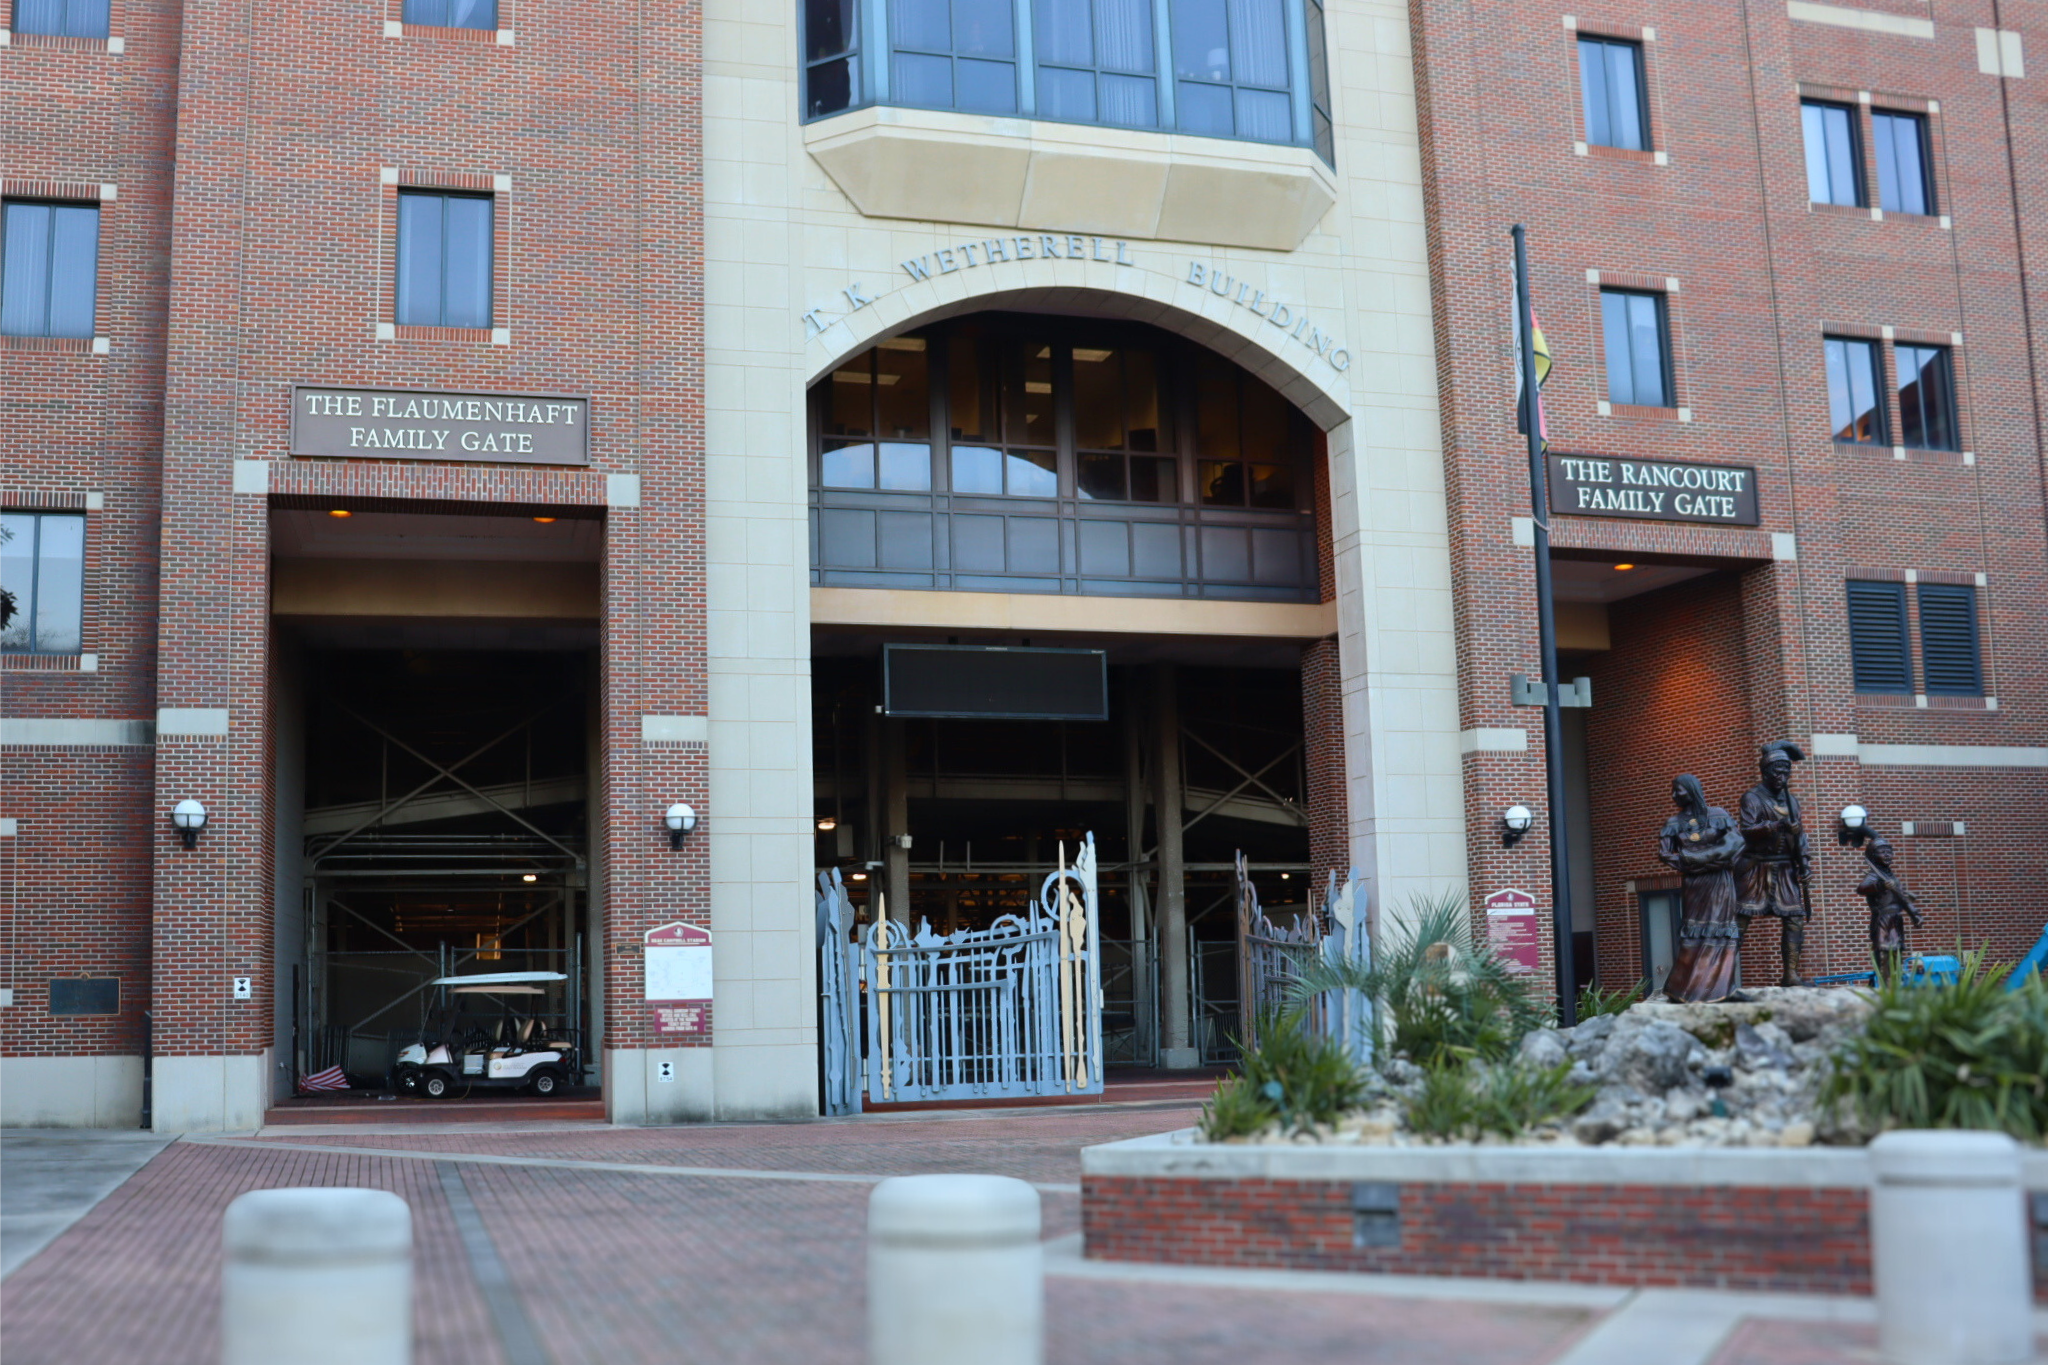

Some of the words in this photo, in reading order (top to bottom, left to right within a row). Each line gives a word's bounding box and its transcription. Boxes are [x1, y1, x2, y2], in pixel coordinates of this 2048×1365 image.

[801, 307, 835, 333] T.
[842, 281, 880, 311] K.
[900, 234, 1135, 282] WETHERELL
[1186, 261, 1353, 373] BUILDING
[306, 394, 363, 417] THE
[371, 397, 578, 425] FLAUMENHAFT
[350, 427, 450, 450] FAMILY
[460, 431, 534, 453] GATE
[1561, 459, 1612, 483] THE
[1620, 463, 1745, 492] RANCOURT
[1577, 487, 1665, 513] FAMILY
[1674, 493, 1736, 518] GATE
